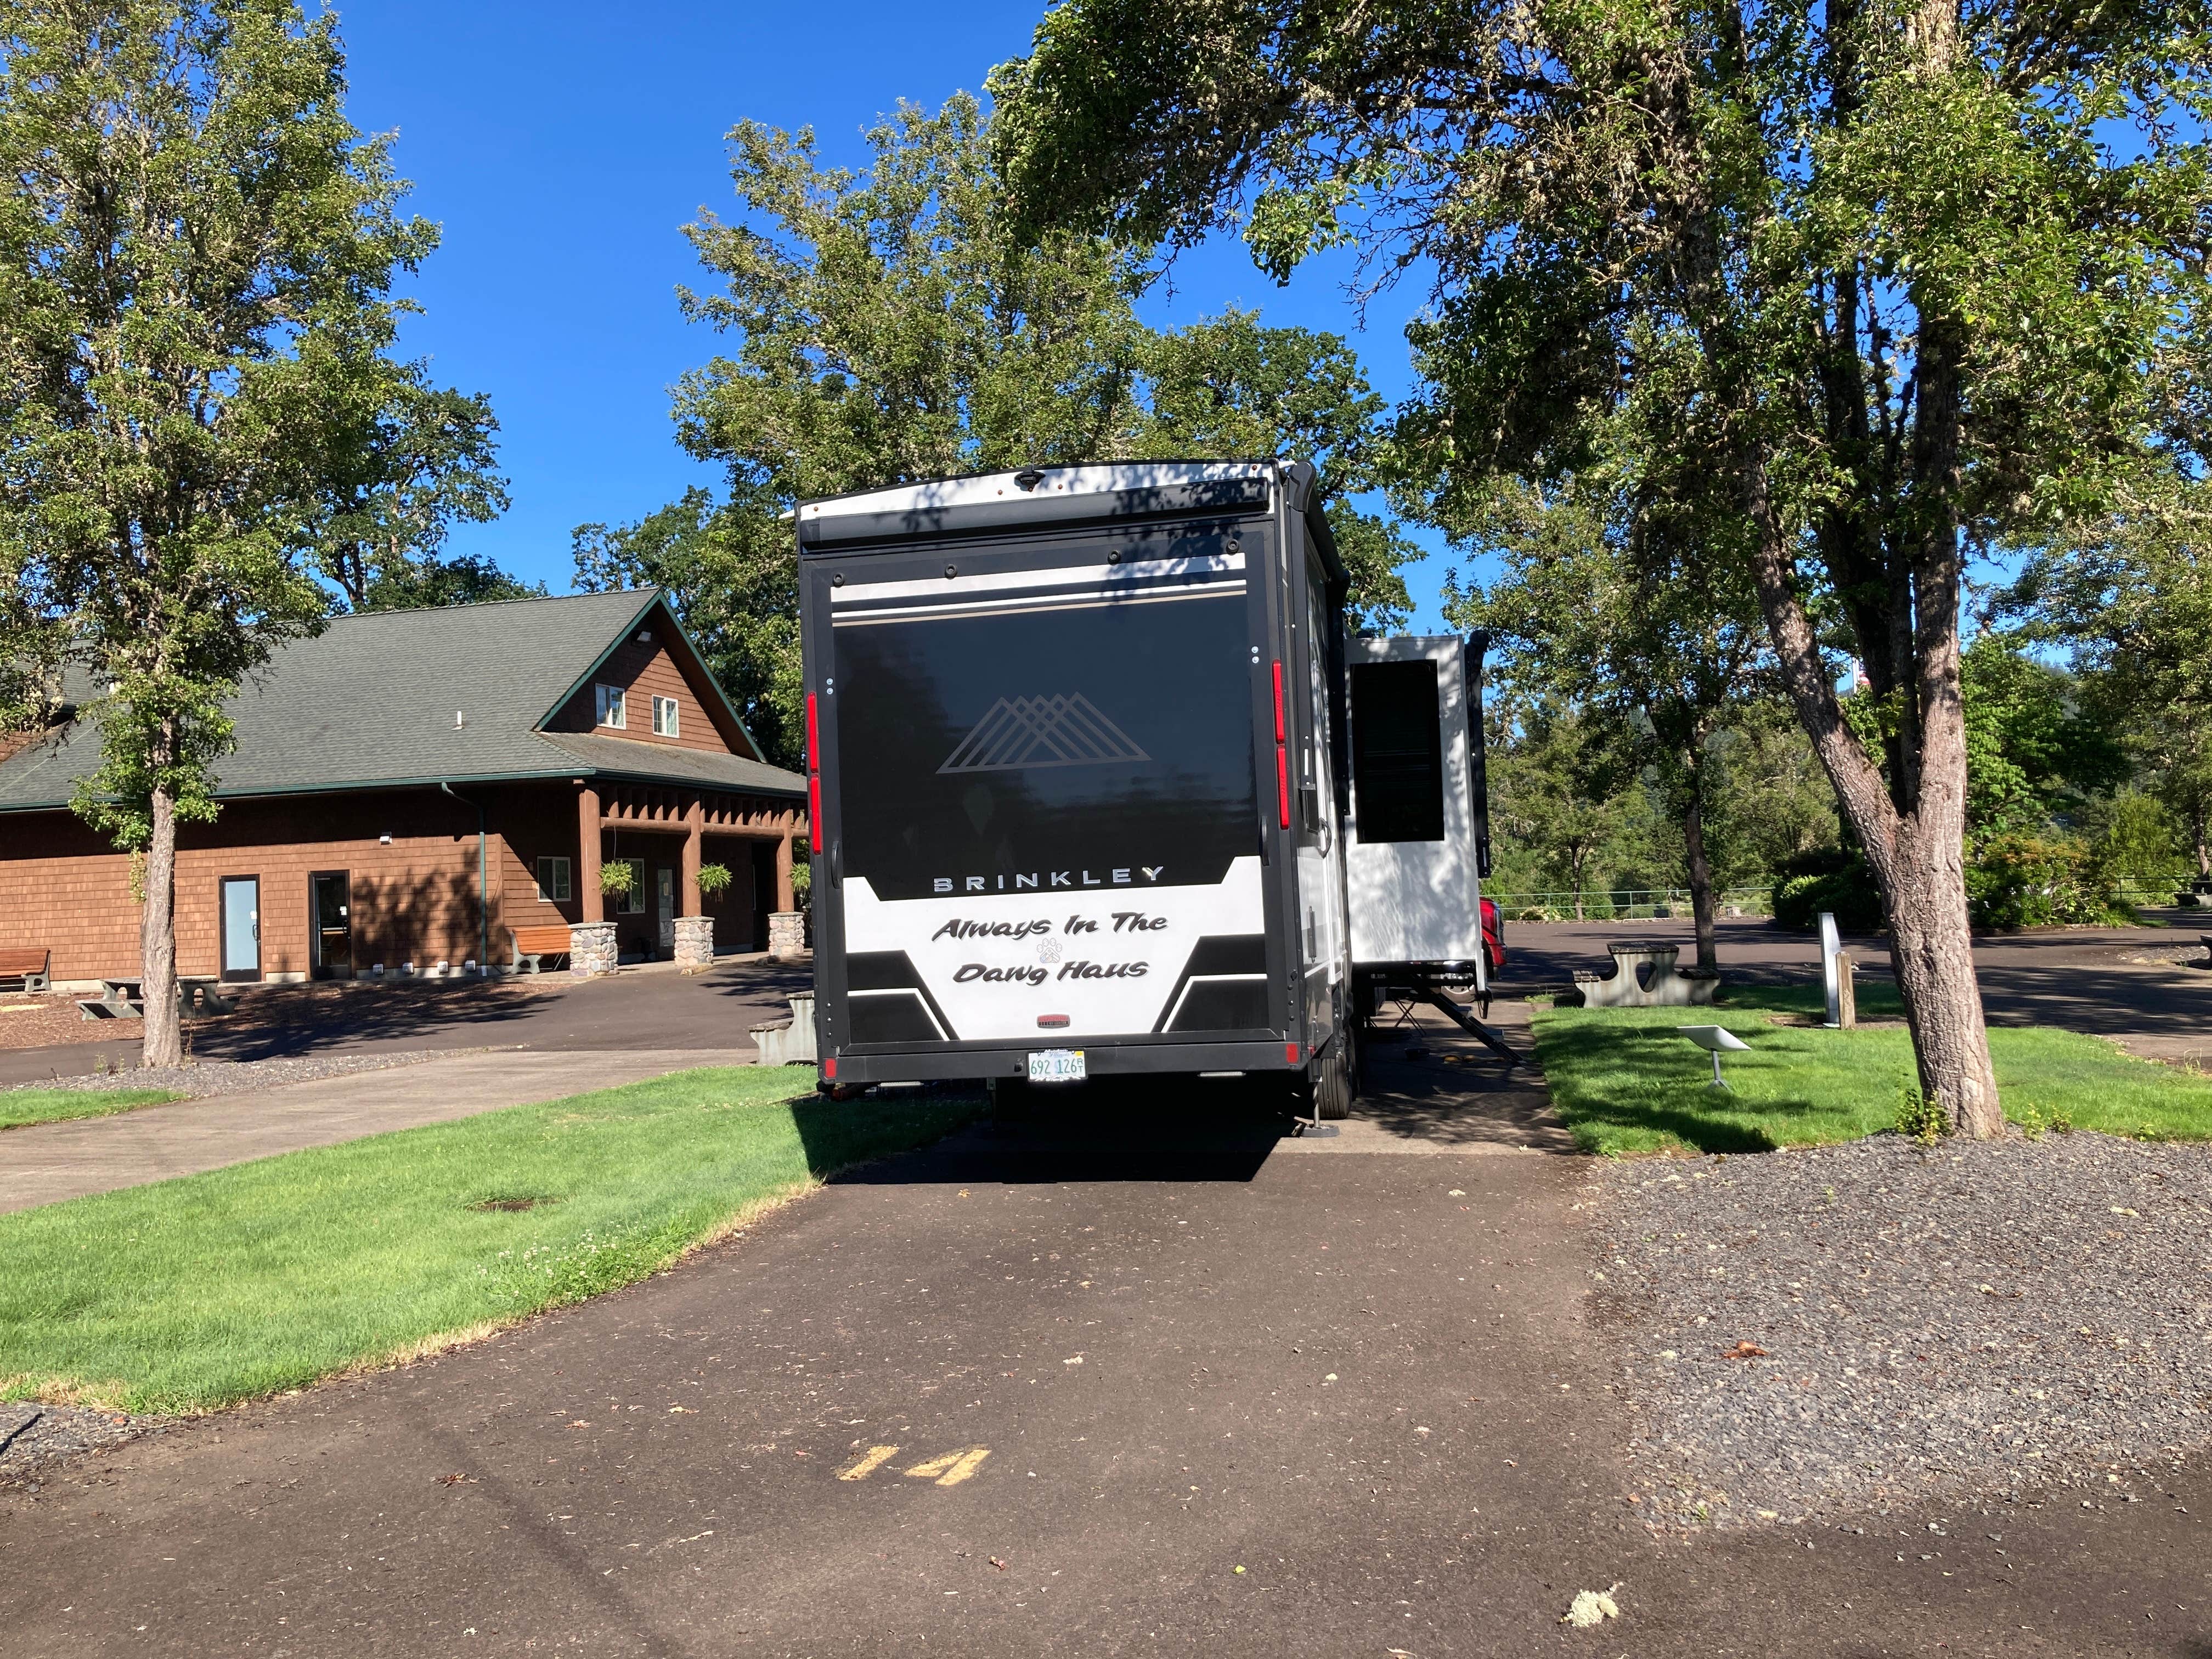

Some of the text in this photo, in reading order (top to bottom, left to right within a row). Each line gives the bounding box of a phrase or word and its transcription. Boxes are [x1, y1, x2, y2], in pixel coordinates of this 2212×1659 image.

[934, 866, 1164, 891] BRINKLEY
[932, 911, 1168, 941] Always In The
[953, 961, 1150, 986] Dawg Haus
[1031, 1058, 1076, 1074] 692 126
